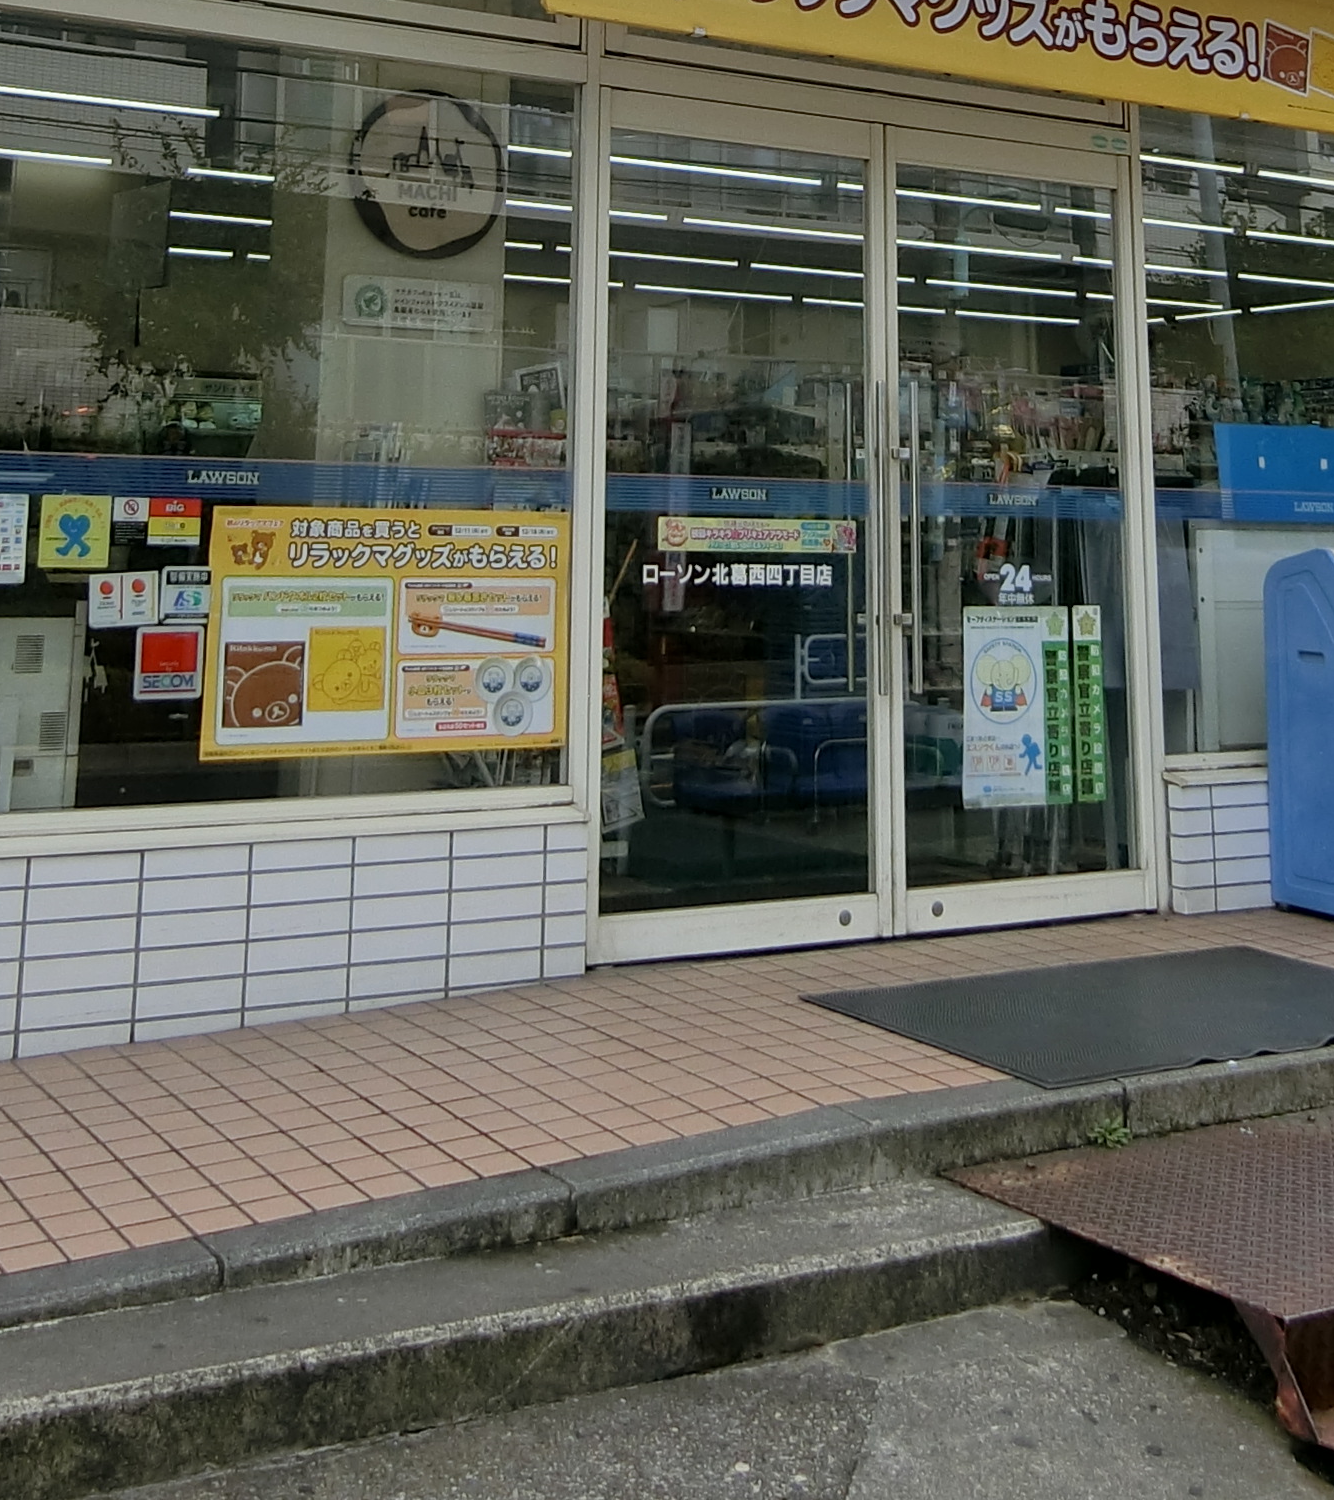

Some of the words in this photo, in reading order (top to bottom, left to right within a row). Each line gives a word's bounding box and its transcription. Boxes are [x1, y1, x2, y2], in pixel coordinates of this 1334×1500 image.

[397, 183, 458, 202] MACHI
[186, 469, 260, 485] LAWSON
[711, 487, 767, 501] LAWSON
[988, 493, 1038, 506] LAWSON
[165, 500, 185, 512] BIG
[1293, 501, 1334, 513] LAWSON
[290, 517, 422, 540] 対象商品を買うと
[642, 562, 833, 587] ローソン北葛西四丁目店
[999, 562, 1033, 592] 24
[141, 673, 195, 689] SECOM
